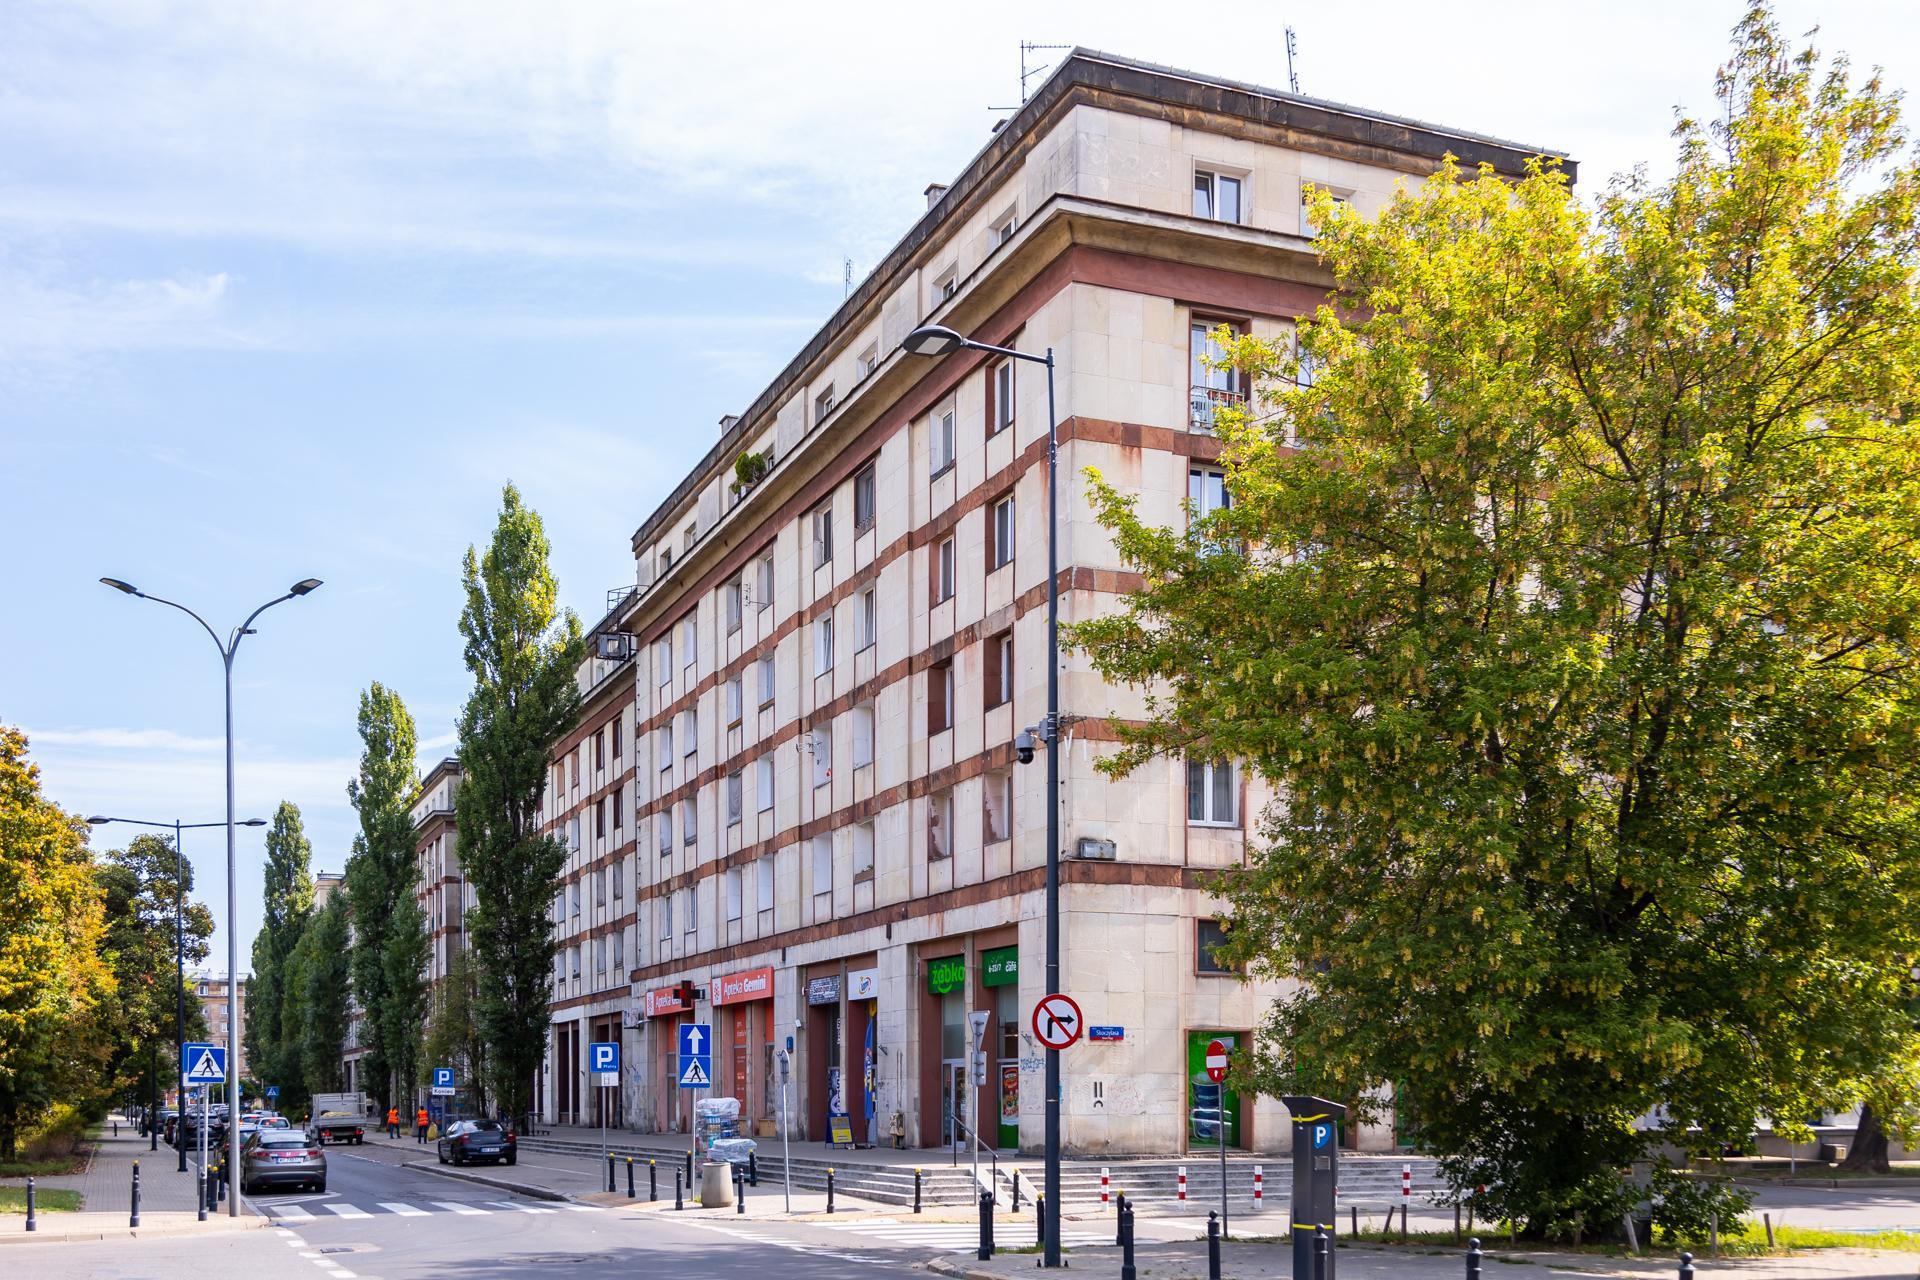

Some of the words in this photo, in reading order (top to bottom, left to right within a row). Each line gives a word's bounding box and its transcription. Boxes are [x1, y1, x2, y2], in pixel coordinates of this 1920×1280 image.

[724, 979, 743, 998] Apteka
[743, 974, 766, 992] Gemini
[656, 994, 671, 1011] Apteka
[597, 1047, 613, 1069] P
[438, 1071, 450, 1085] P
[1316, 1127, 1327, 1143] P
